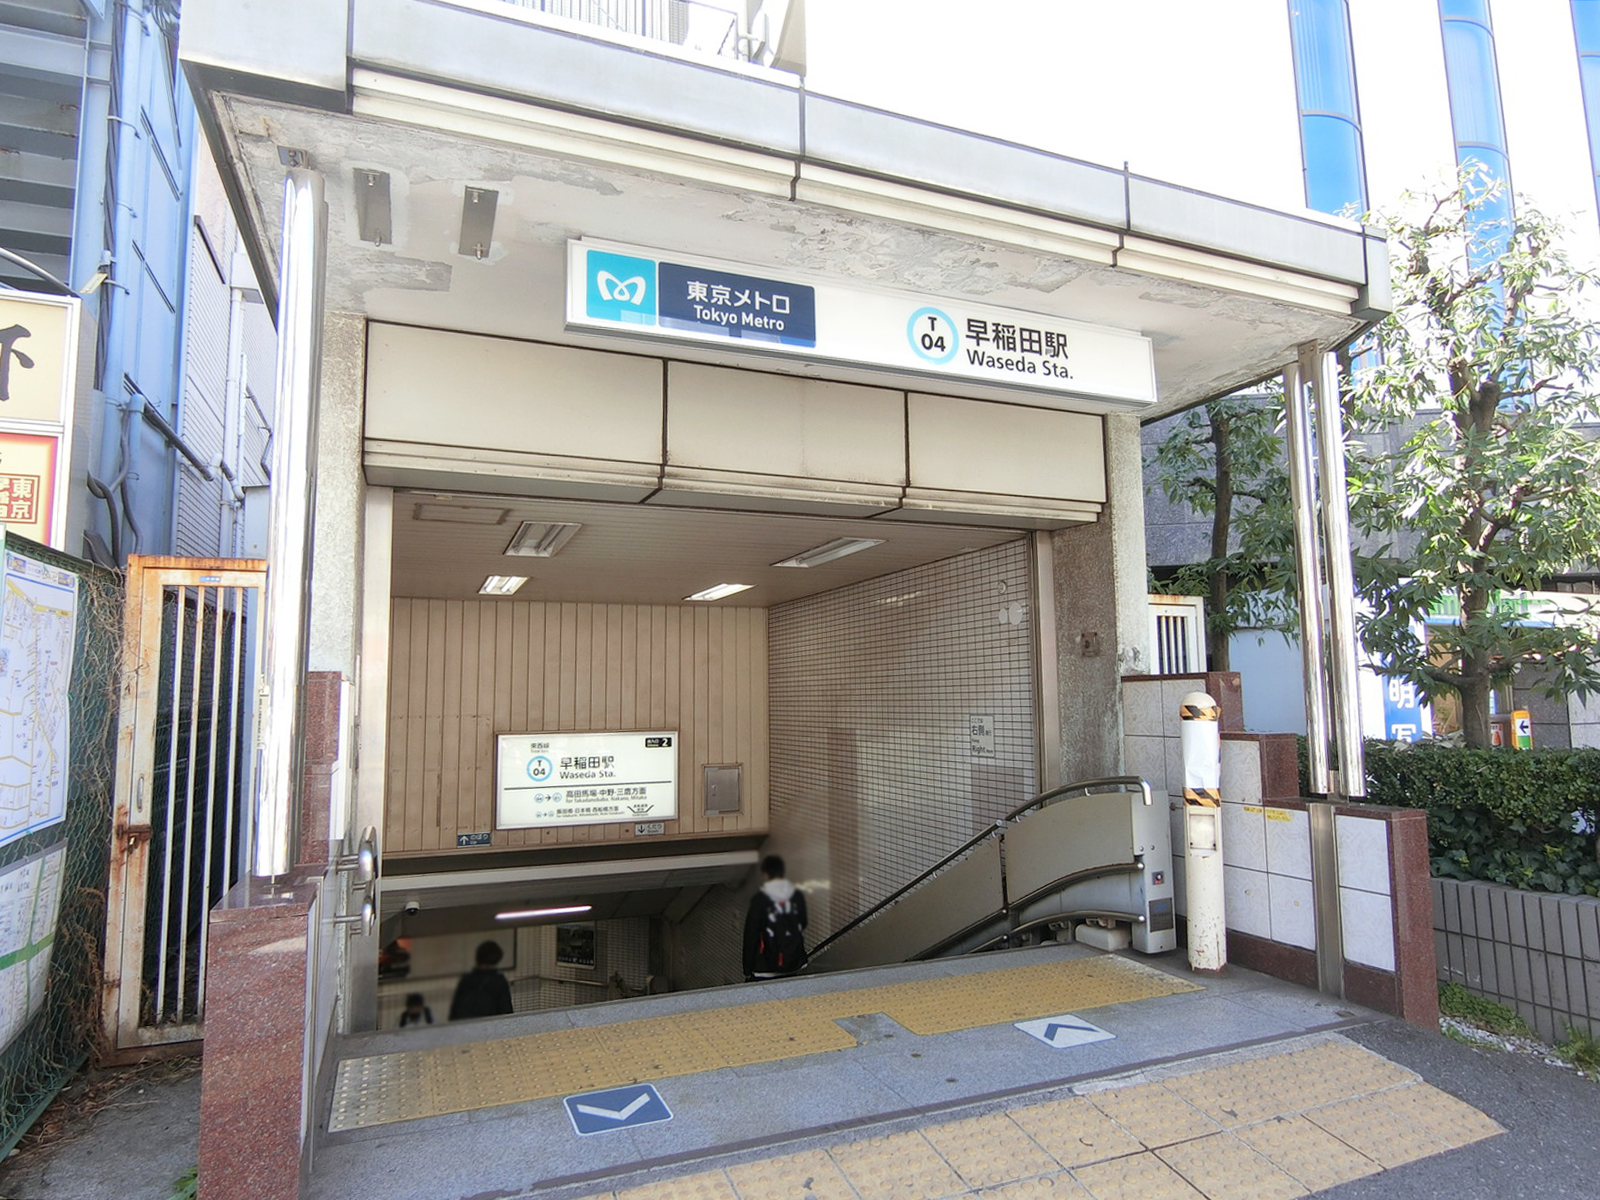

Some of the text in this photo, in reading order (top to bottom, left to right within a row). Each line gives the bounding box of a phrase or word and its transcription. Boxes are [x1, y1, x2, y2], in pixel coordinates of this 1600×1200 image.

[686, 279, 790, 315] 東京メトロ
[693, 303, 785, 332] Tokyo Metro
[927, 315, 939, 332] T
[920, 333, 947, 354] 04
[964, 317, 1069, 361] 早稲田駅
[966, 348, 1075, 381] Waseda Sta.
[661, 738, 669, 747] 2
[532, 768, 546, 776] 04
[560, 755, 615, 770] 早稲田駅
[559, 769, 616, 780] Waseda Sta.
